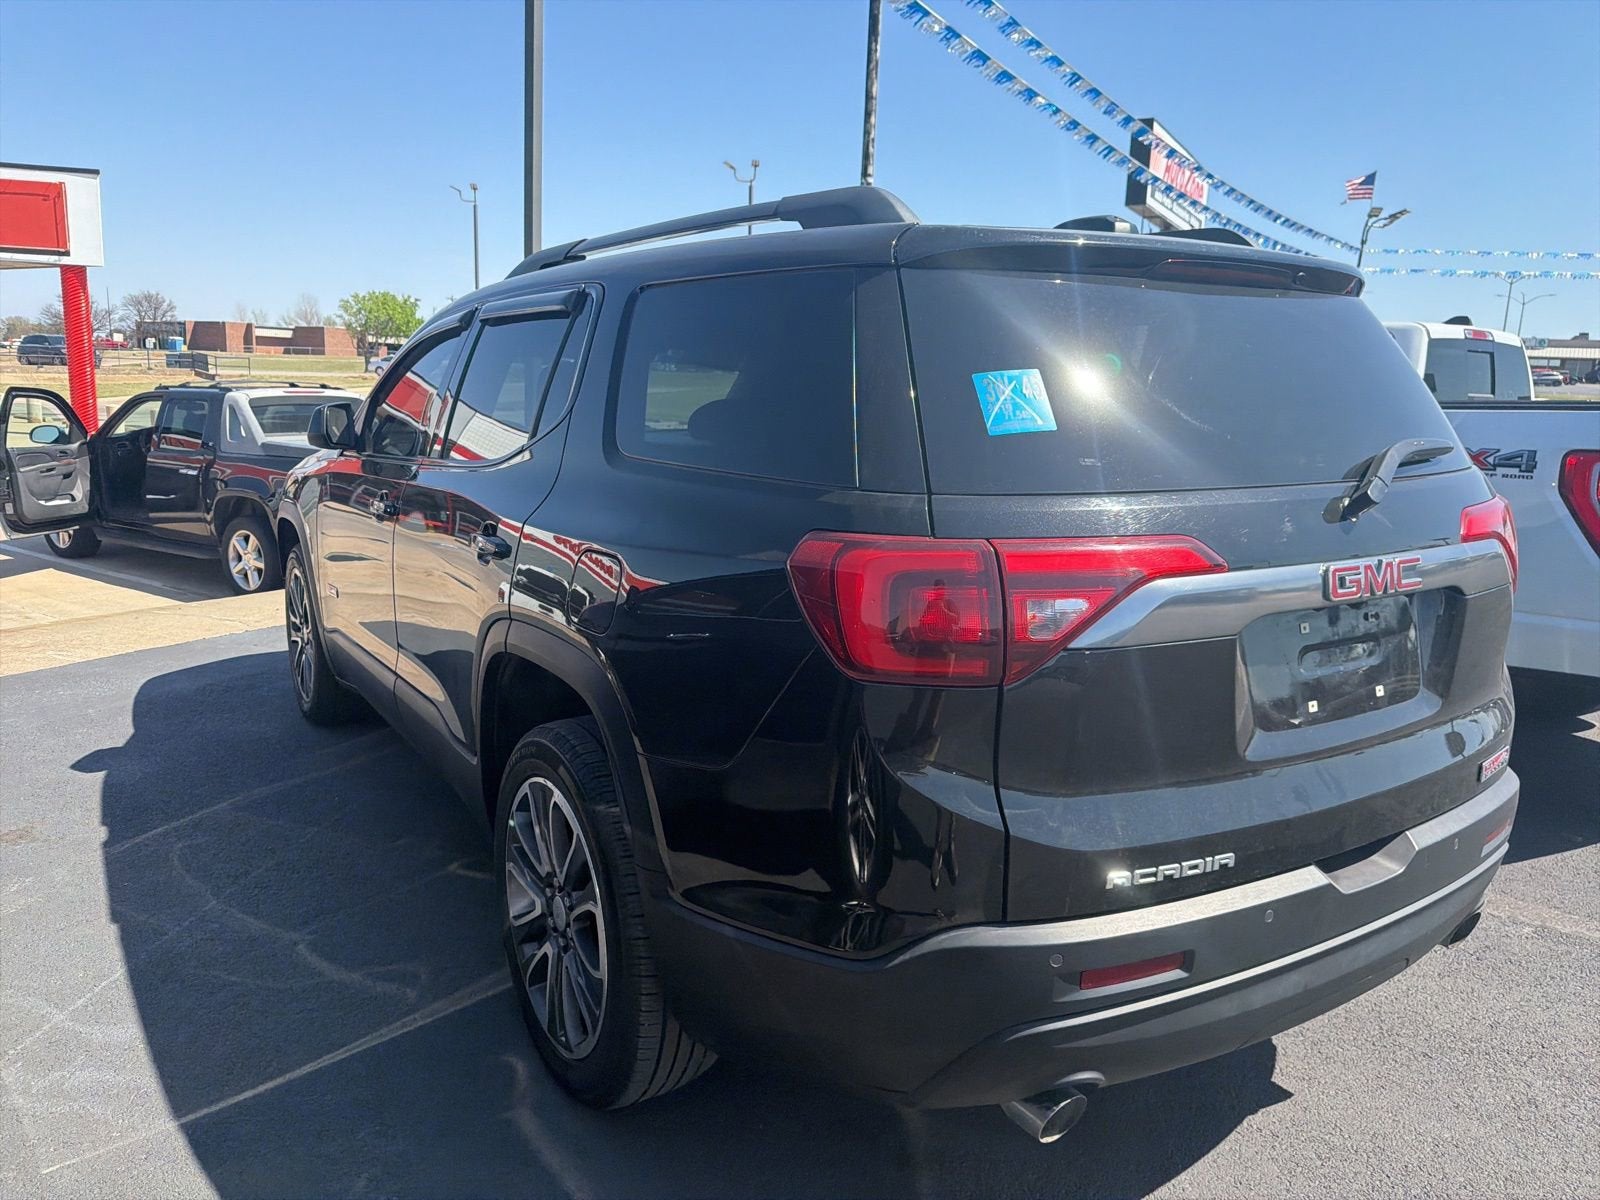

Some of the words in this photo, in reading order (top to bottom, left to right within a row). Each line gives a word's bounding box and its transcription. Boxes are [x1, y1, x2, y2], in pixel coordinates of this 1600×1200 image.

[1464, 447, 1537, 473] X4
[1329, 555, 1423, 601] GMC
[1105, 852, 1235, 890] ACADIA
